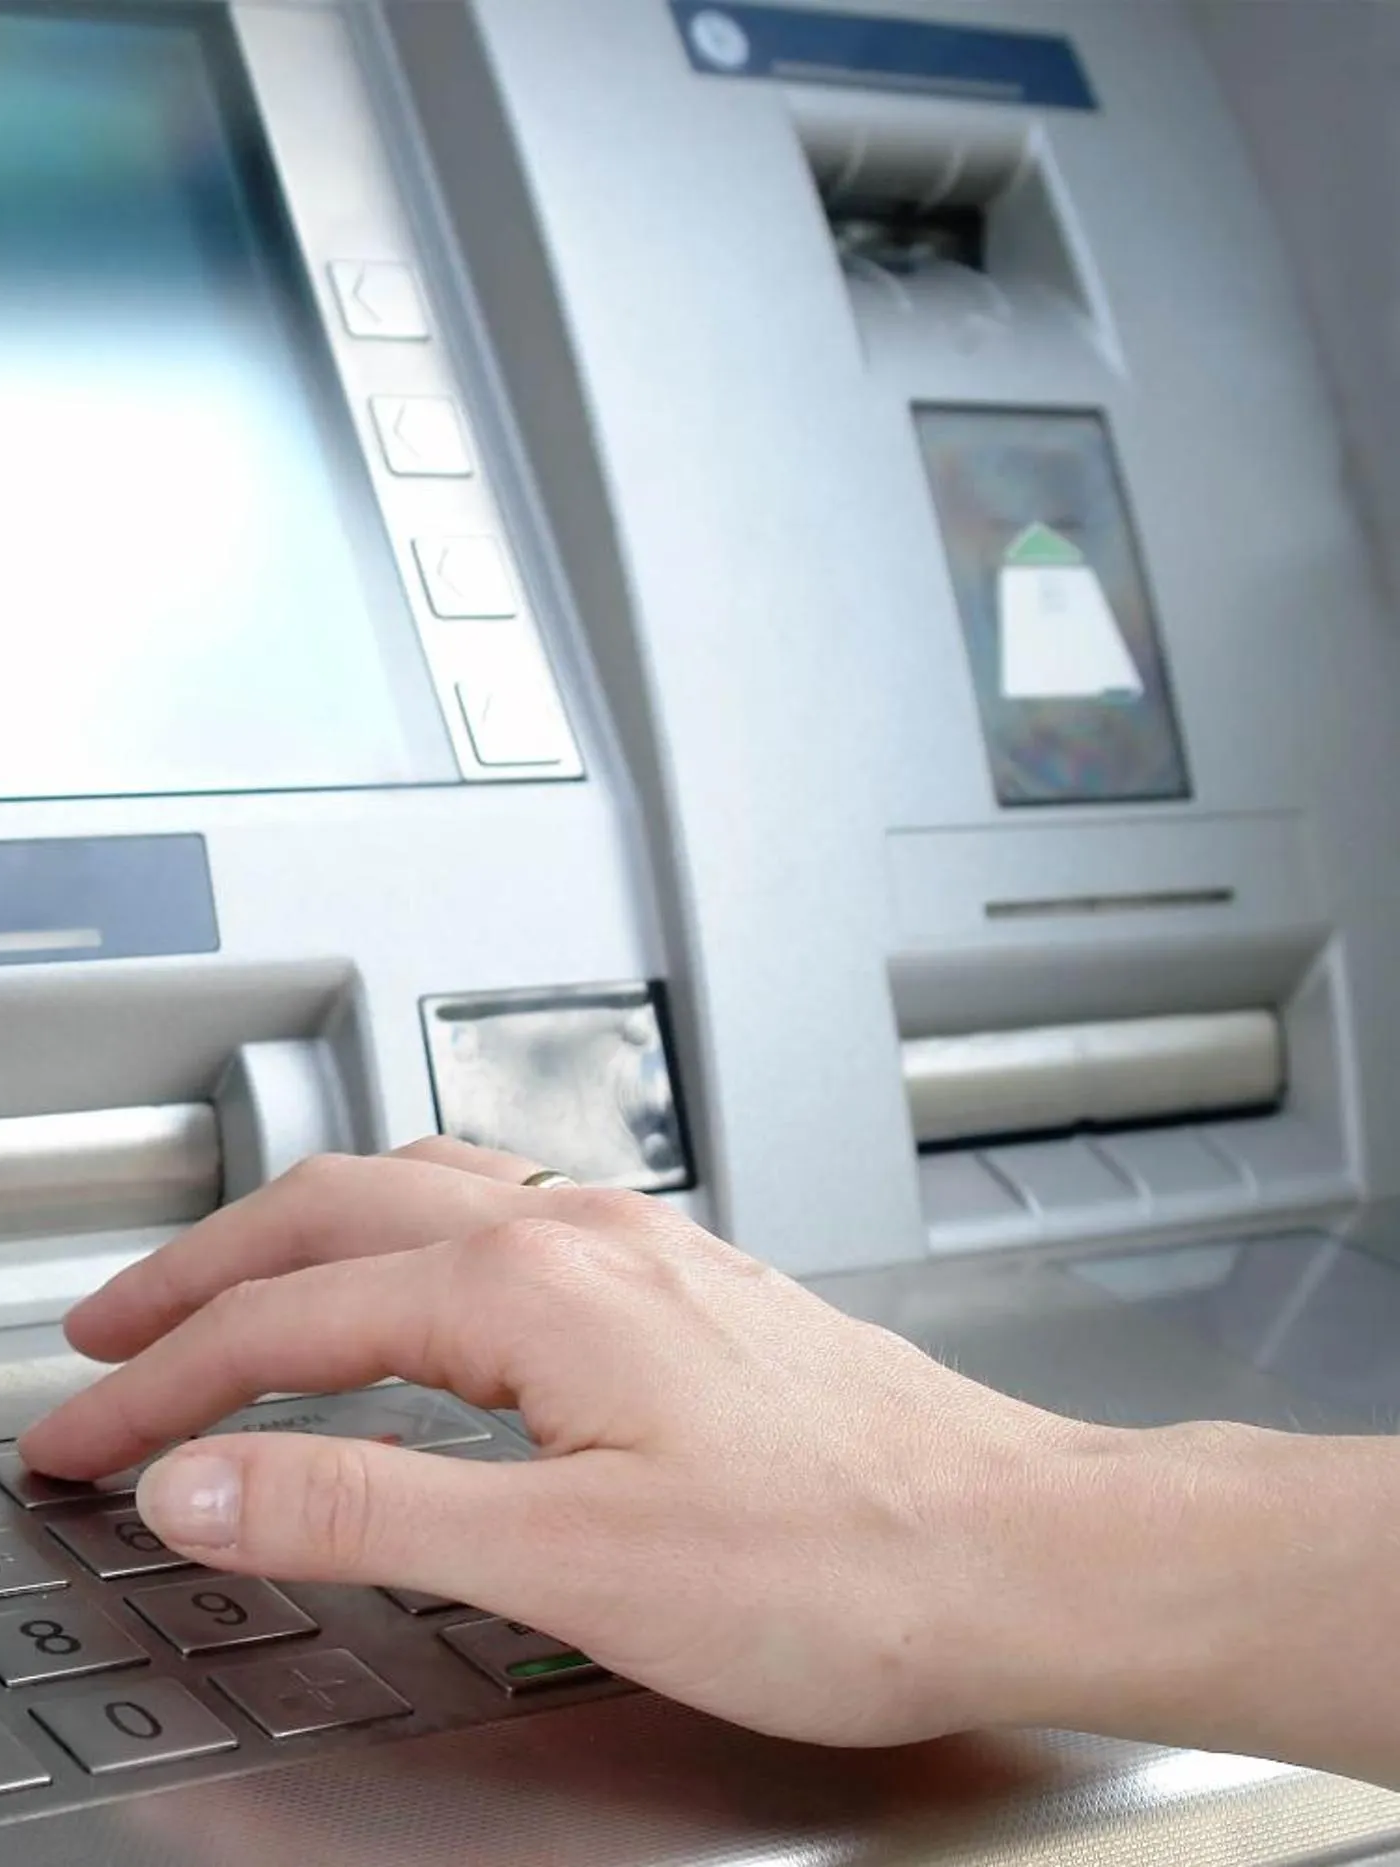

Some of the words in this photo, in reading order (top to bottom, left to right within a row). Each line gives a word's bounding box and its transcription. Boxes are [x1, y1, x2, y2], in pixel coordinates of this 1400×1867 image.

[114, 1521, 166, 1551] 6
[190, 1591, 249, 1627] 9
[19, 1619, 82, 1656] 8
[104, 1700, 163, 1740] 0
